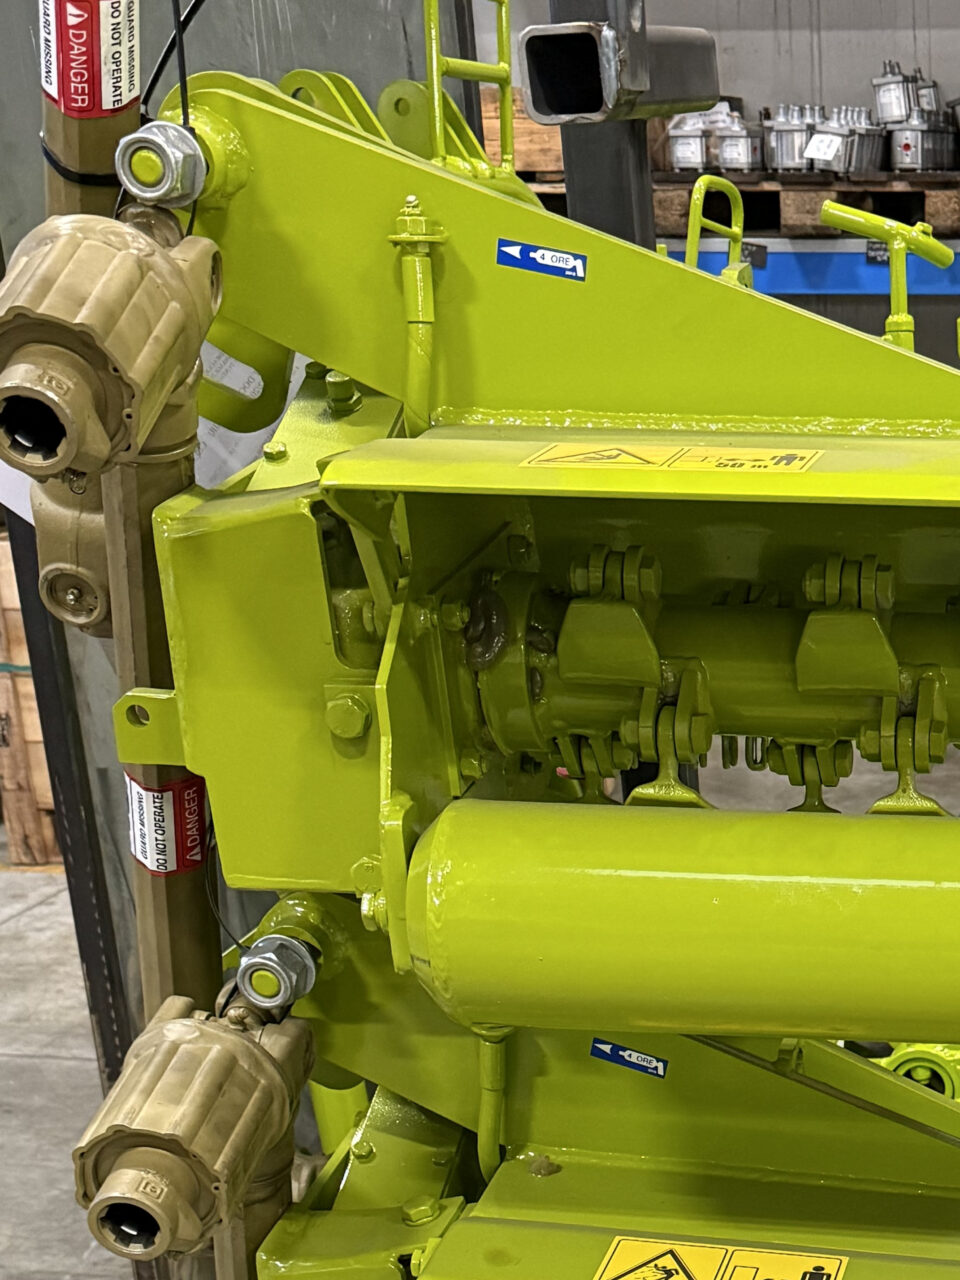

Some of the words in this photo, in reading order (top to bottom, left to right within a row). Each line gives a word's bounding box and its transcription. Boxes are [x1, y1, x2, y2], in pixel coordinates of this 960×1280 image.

[42, 0, 51, 36] UARD
[110, 1, 121, 19] DO
[127, 0, 135, 43] GUARD
[110, 22, 122, 47] NOT
[43, 37, 52, 86] MISSING
[69, 29, 88, 107] DANGER
[111, 51, 123, 107] OPERATE
[127, 45, 136, 93] MISSING
[550, 254, 571, 266] ORE
[152, 793, 165, 836] OPERATE
[184, 787, 200, 847] DANGER
[155, 837, 167, 856] NOT
[155, 858, 168, 871] DO
[636, 1055, 654, 1066] ORE
